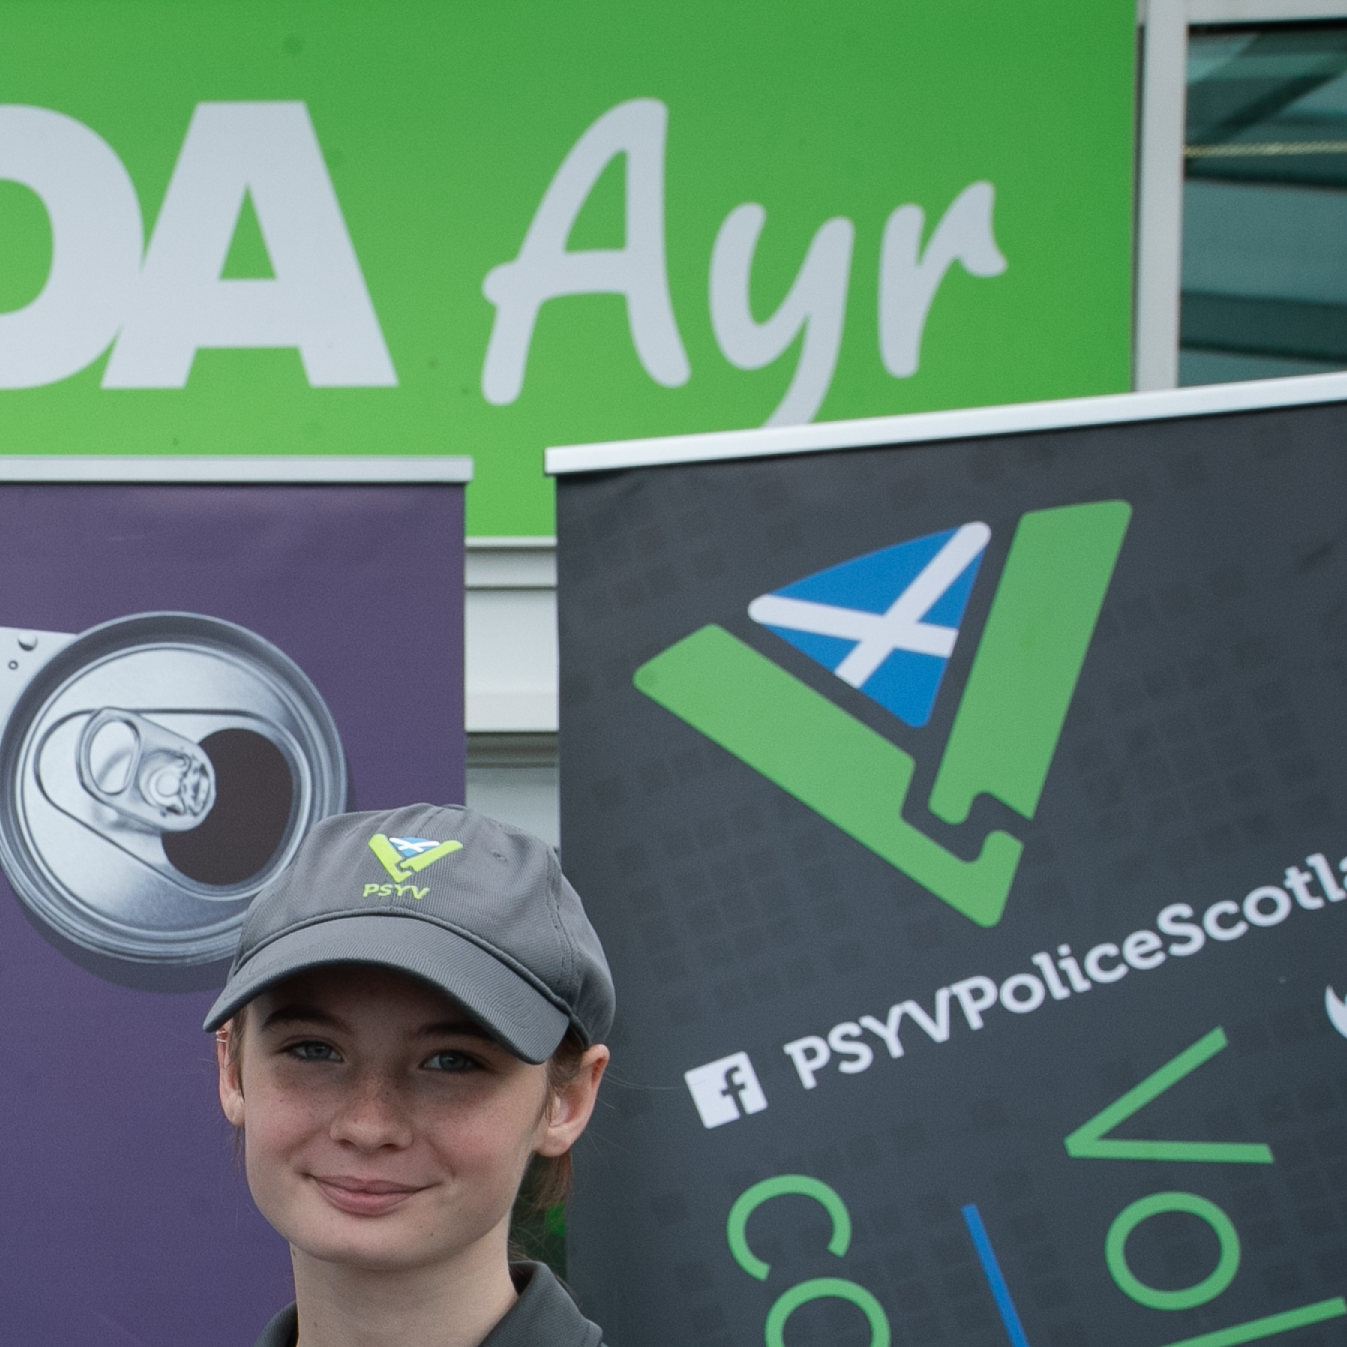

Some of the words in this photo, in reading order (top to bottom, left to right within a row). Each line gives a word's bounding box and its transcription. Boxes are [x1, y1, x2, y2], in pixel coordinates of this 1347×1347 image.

[481, 98, 1009, 430] Ayr
[362, 882, 431, 900] PSYV
[783, 852, 1347, 1091] PSYVPoliceScotl
